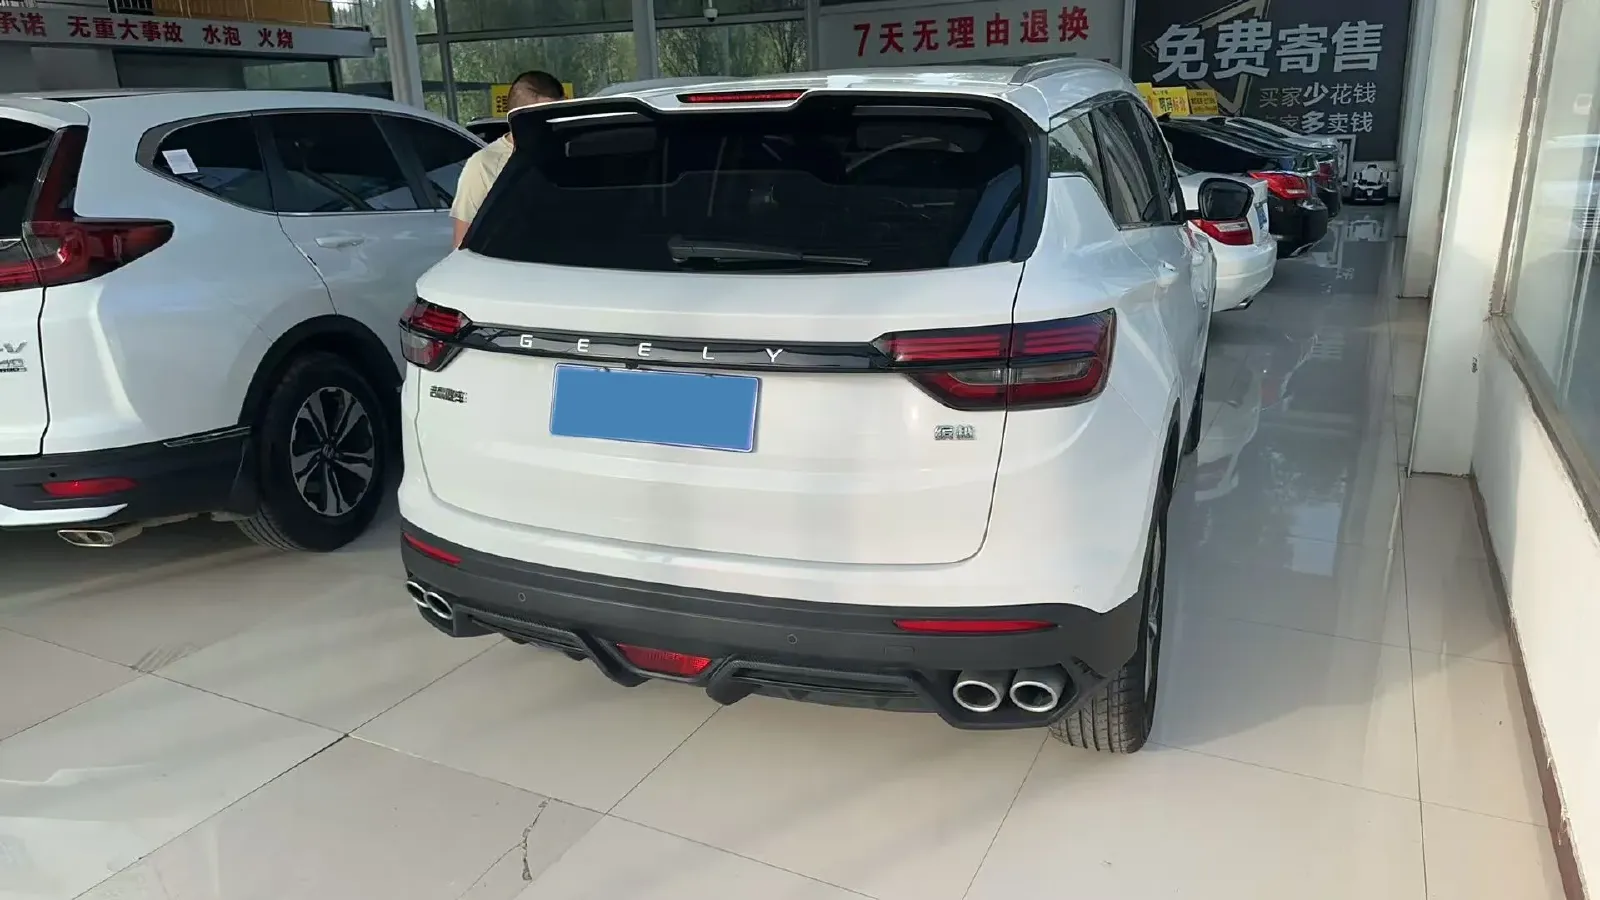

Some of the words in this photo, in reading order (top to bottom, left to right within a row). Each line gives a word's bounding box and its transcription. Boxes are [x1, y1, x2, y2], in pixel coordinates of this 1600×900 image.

[0, 11, 47, 37] 承诺
[67, 15, 183, 43] 无重大事故
[203, 25, 242, 46] 水泡
[257, 28, 294, 49] 火烧
[853, 6, 1089, 57] 7天无理由退换
[1152, 18, 1384, 82] 免费寄售
[1259, 82, 1377, 108] 买家少花钱
[1264, 111, 1373, 134] 家多卖钱
[519, 334, 783, 363] GEELY
